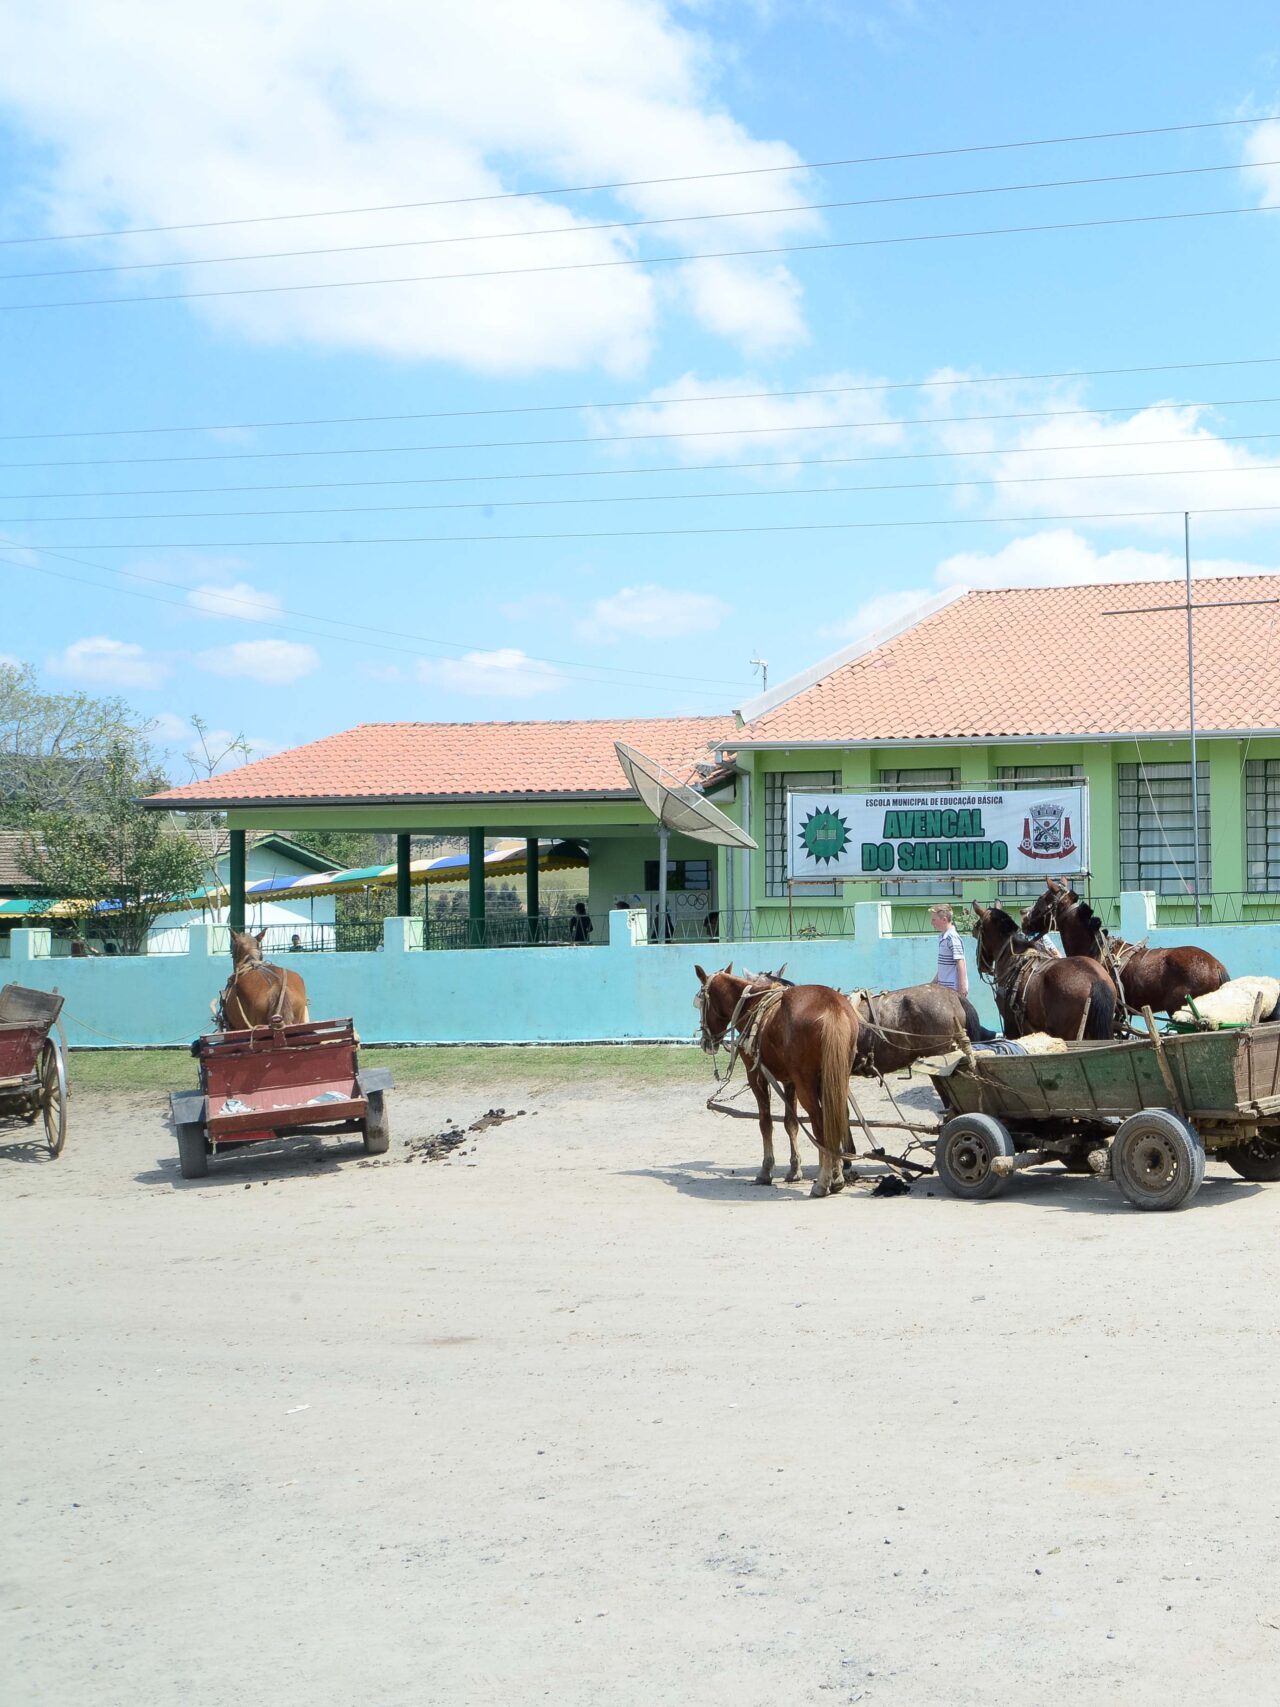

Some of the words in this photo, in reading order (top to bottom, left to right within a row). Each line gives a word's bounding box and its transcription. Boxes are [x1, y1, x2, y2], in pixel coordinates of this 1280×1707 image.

[866, 798, 890, 807] ESCOLA
[892, 797, 928, 807] MUNICIPAL
[930, 797, 939, 806] DE
[940, 795, 976, 806] EDUCAÇÃO
[978, 795, 1003, 805] BÁSICA
[883, 808, 985, 839] AVENCAL
[861, 842, 894, 872] DO
[897, 840, 1008, 872] SALTINHO
